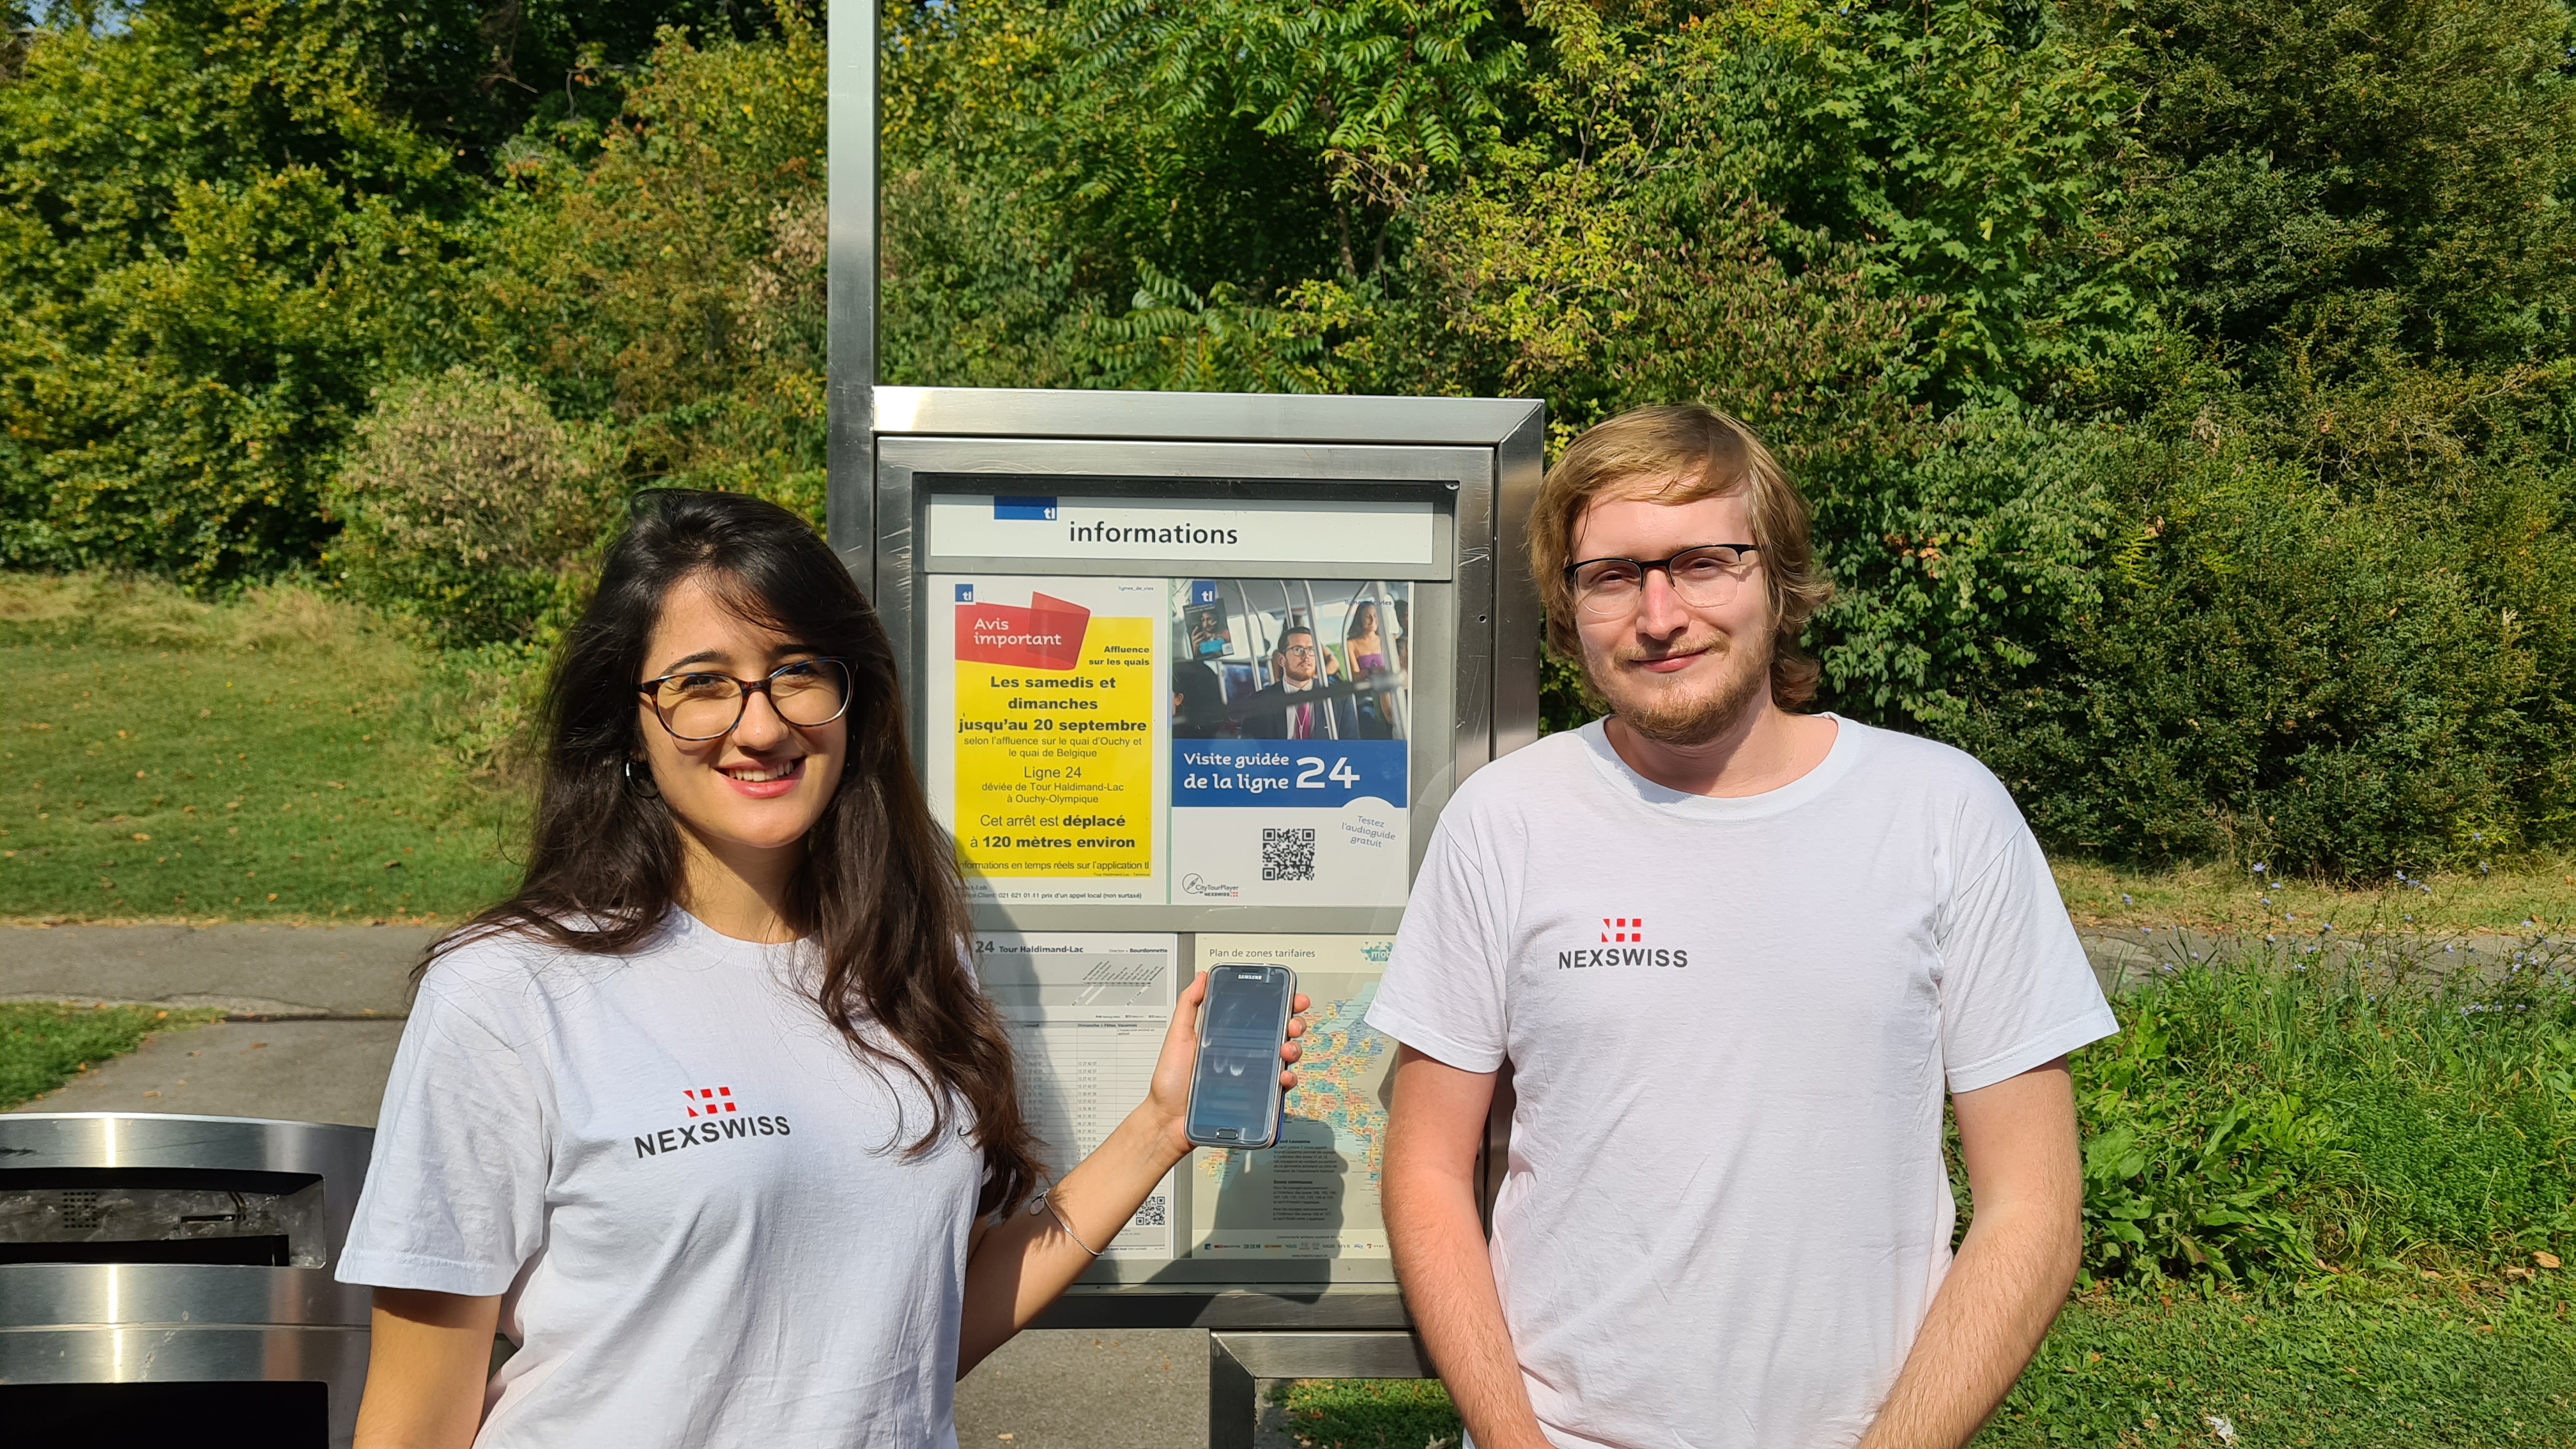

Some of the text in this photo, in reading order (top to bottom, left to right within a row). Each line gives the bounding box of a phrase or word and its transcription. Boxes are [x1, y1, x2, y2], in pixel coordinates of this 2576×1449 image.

[1043, 507, 1055, 519] tl
[1070, 521, 1238, 544] informations
[962, 590, 972, 601] tl
[1201, 591, 1213, 602] tl
[974, 617, 1009, 631] Avis
[974, 632, 1062, 647] important
[1103, 645, 1150, 654] Affluence
[1123, 658, 1150, 668] quais
[990, 676, 1117, 689] Les samedis et
[1008, 697, 1099, 710] dimanches
[1033, 719, 1054, 731] 20
[1059, 719, 1147, 733] septembre
[963, 737, 990, 746] selon
[992, 737, 1039, 746] l'affluence
[1059, 737, 1067, 746] le
[1070, 737, 1090, 747] quai
[1092, 737, 1130, 747] d'Ouchy
[1019, 749, 1039, 758] quai
[1042, 749, 1054, 757] de
[1056, 749, 1098, 759] Belgique
[1183, 753, 1289, 769] Visite guidée
[1023, 766, 1082, 781] Ligne 24
[1296, 756, 1361, 789] 24
[981, 782, 1124, 792] déviée de Tour Haldimand-Lac
[1183, 774, 1289, 793] de la ligne
[1006, 795, 1099, 805] à Ouchy-Olympique
[979, 815, 1126, 830] Cet arrêt est déplacé
[1357, 815, 1385, 828] Testez
[970, 836, 1135, 848] à 120 mètres environ
[1349, 835, 1383, 848] gratuit
[960, 861, 1009, 870] nformations
[1025, 861, 1052, 871] temps
[1054, 861, 1075, 870] réels
[1092, 861, 1142, 871] l'application
[975, 940, 995, 953] 24
[1020, 945, 1084, 953] Haldimand-Lac
[1209, 949, 1229, 958] Plan
[1232, 949, 1243, 958] de
[1275, 949, 1315, 958] tarifaires
[1559, 948, 1688, 969] NEXSWISS
[634, 1116, 791, 1159] NEXSWISS
